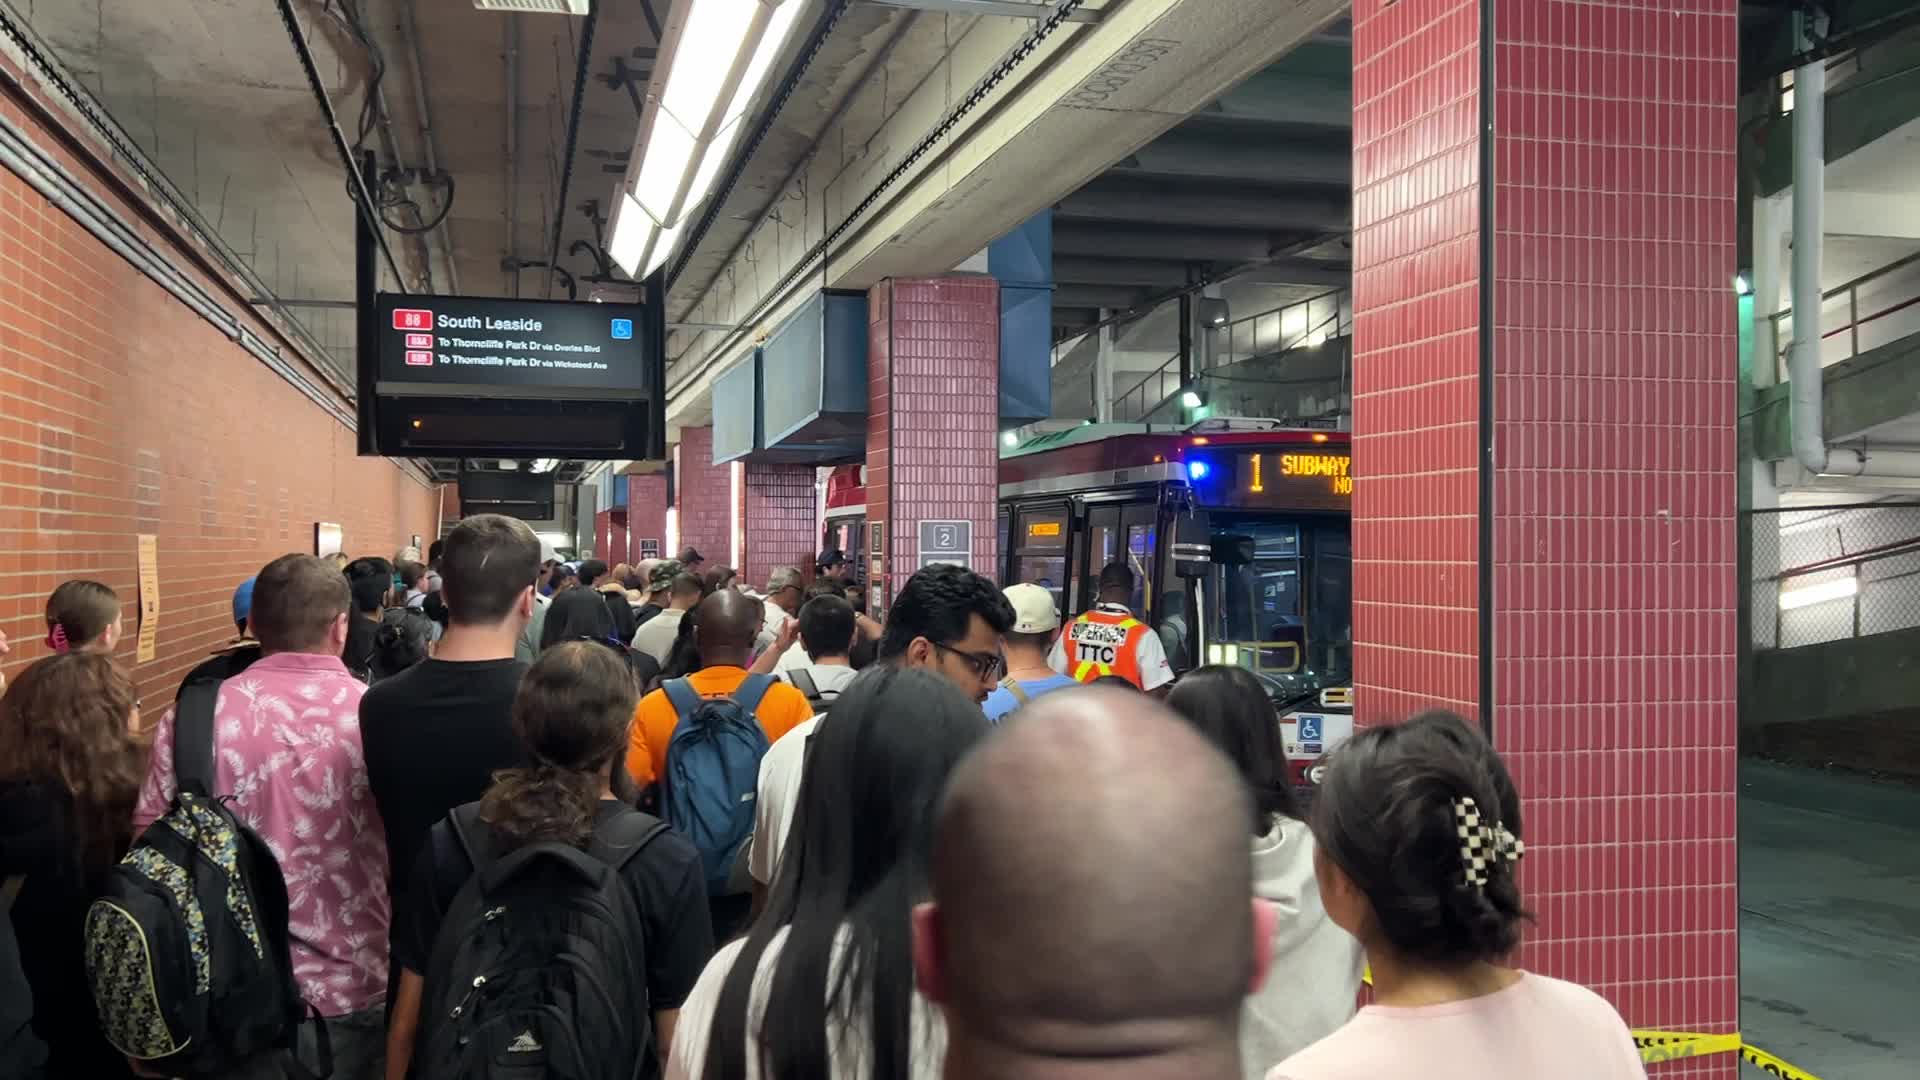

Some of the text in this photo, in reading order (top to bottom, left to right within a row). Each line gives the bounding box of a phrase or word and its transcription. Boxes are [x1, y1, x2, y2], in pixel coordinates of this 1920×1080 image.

[405, 313, 543, 332] 88 South Leaside
[438, 337, 451, 347] To
[452, 338, 503, 349] Thorncliffe
[505, 340, 528, 350] Park
[529, 341, 541, 351] Dr
[542, 343, 553, 352] via
[584, 345, 601, 353] Blvd
[438, 354, 451, 364] To
[452, 355, 503, 366] Thorncliffe
[505, 357, 528, 367] Park
[529, 358, 541, 367] Dr
[542, 360, 553, 368] via
[593, 361, 608, 370] Ave
[1251, 454, 1350, 492] 1 SUBWAY
[941, 533, 949, 546] 2
[1079, 643, 1114, 663] TTC
